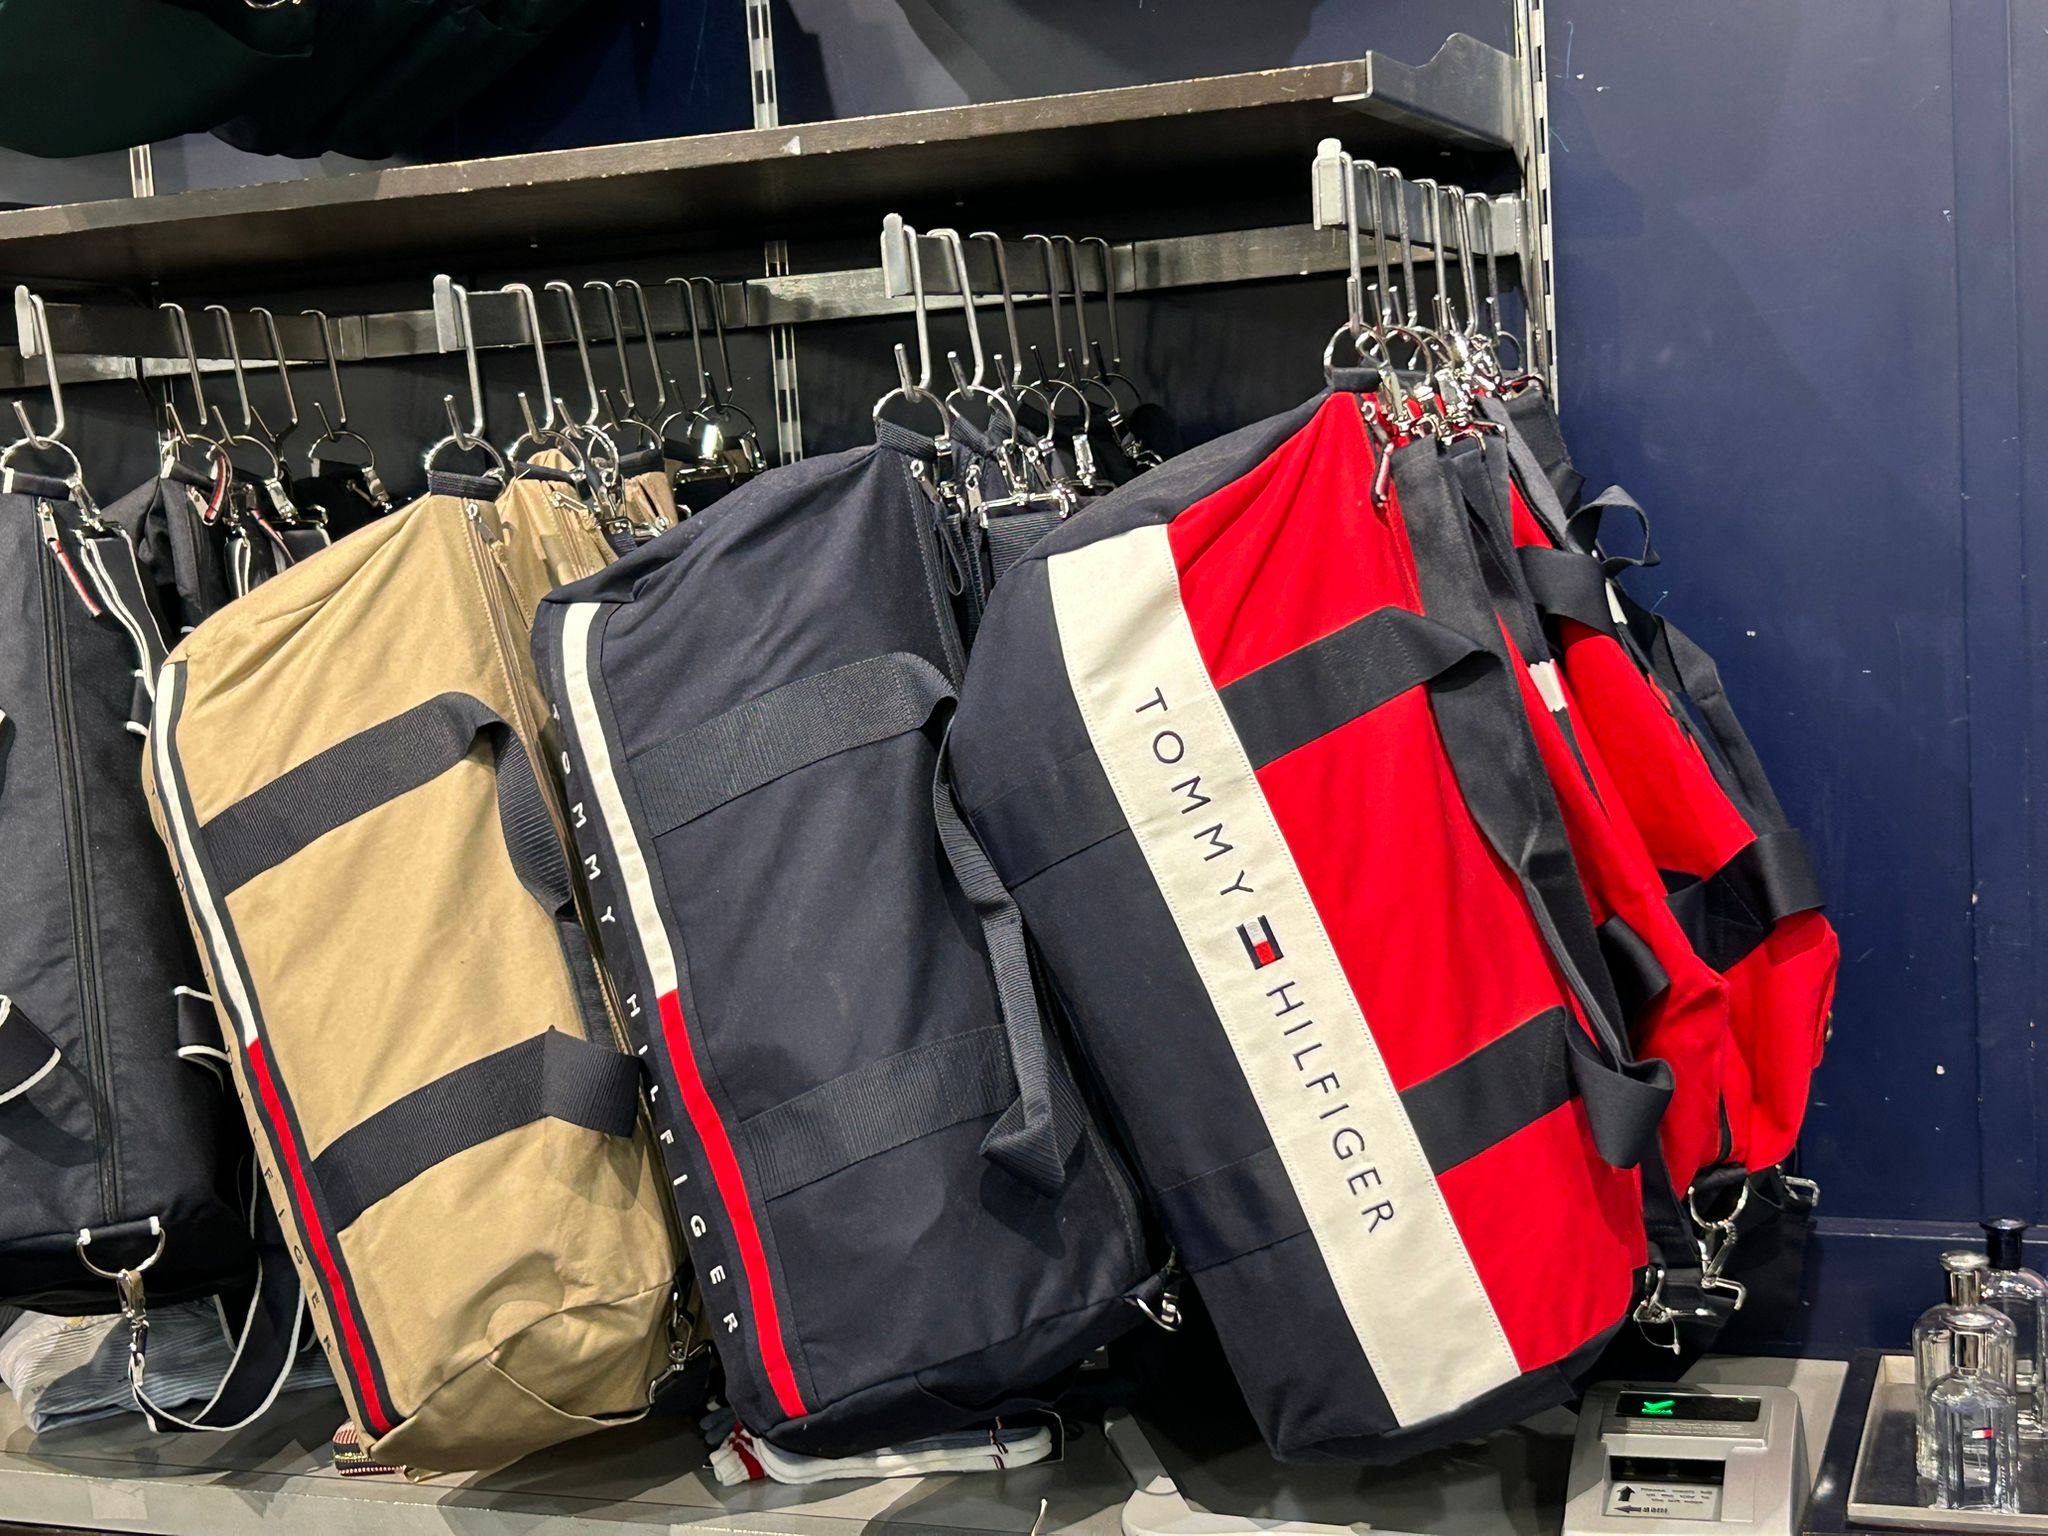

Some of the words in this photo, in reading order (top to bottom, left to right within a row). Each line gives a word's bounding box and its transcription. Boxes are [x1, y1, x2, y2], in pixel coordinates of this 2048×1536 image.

[552, 703, 616, 923] TOMMY
[626, 993, 738, 1333] HILFIGER
[1135, 686, 1254, 897] TOMMY
[1265, 981, 1395, 1234] HILFIGER
